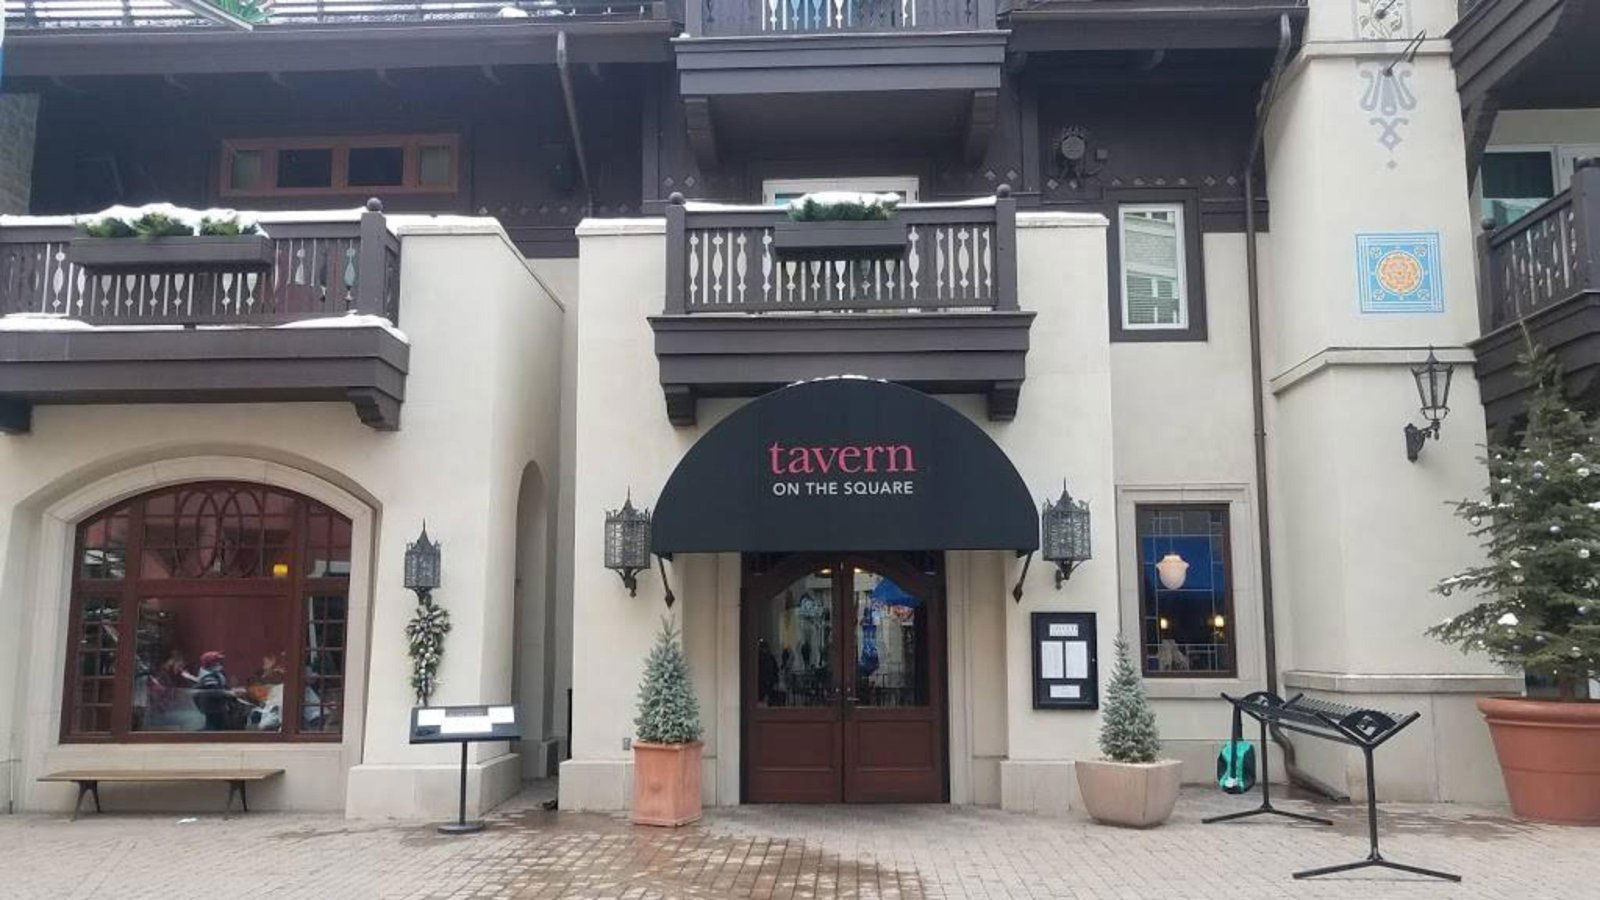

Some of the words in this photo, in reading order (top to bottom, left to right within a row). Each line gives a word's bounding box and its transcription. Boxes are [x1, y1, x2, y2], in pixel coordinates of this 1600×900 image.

[769, 442, 917, 474] tavern
[773, 482, 799, 496] ON
[805, 482, 838, 495] THE
[844, 481, 913, 495] SQUARE
